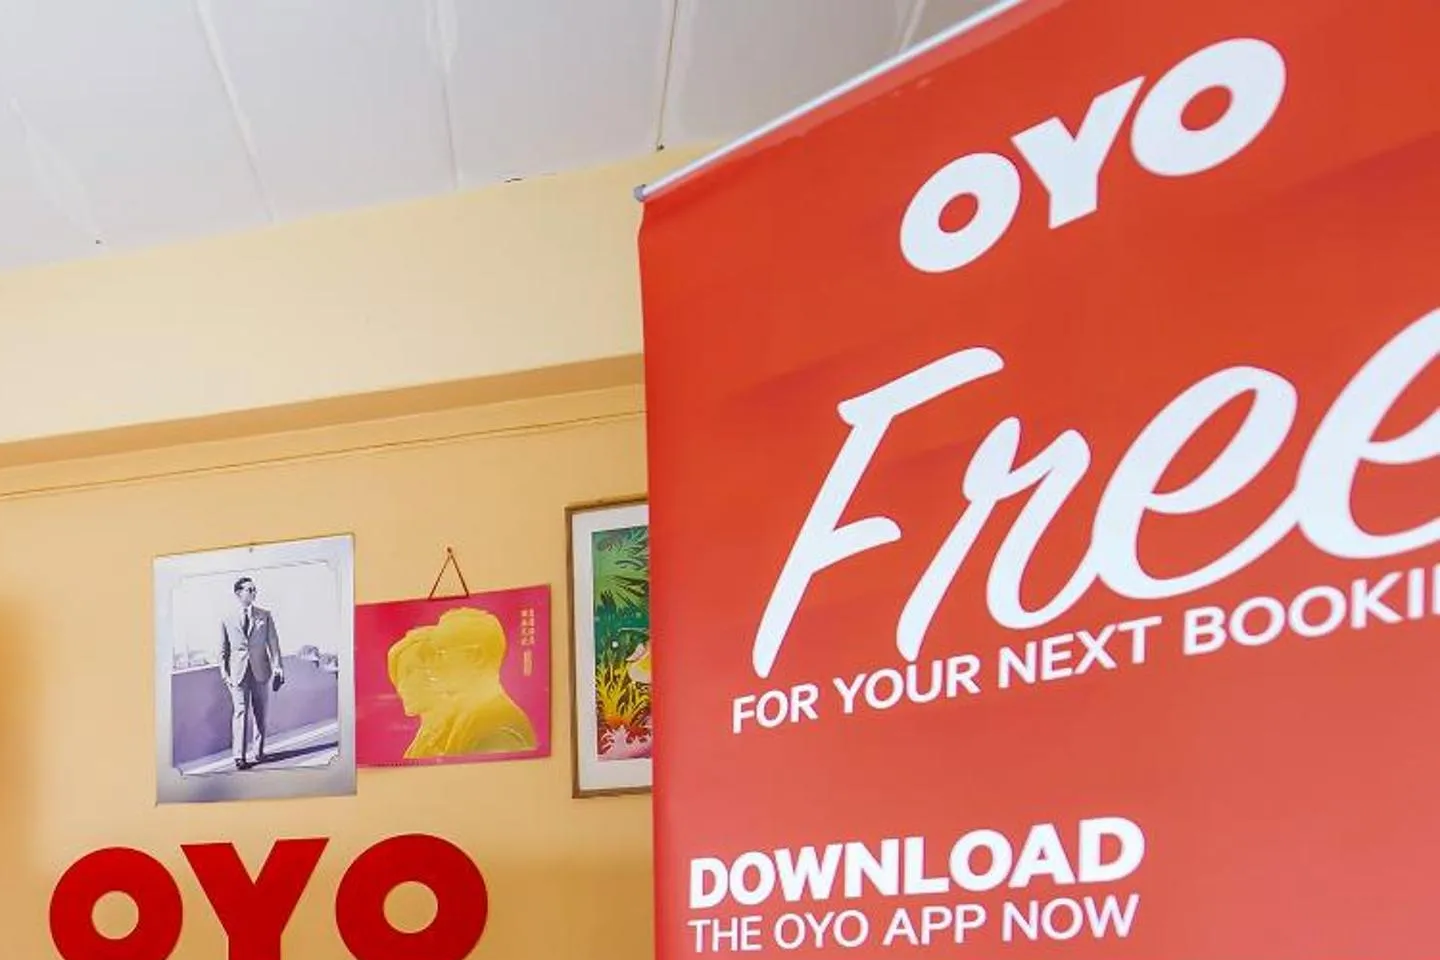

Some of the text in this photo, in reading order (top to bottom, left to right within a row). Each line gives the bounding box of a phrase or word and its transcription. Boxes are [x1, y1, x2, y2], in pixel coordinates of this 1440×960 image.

[899, 37, 1287, 273] OYO
[751, 303, 1440, 679] Free
[731, 563, 1440, 734] FOR YOUR NEXT BOOKI
[687, 894, 1140, 953] THE OYO APP NOW
[689, 816, 1146, 909] DOWNLOAD
